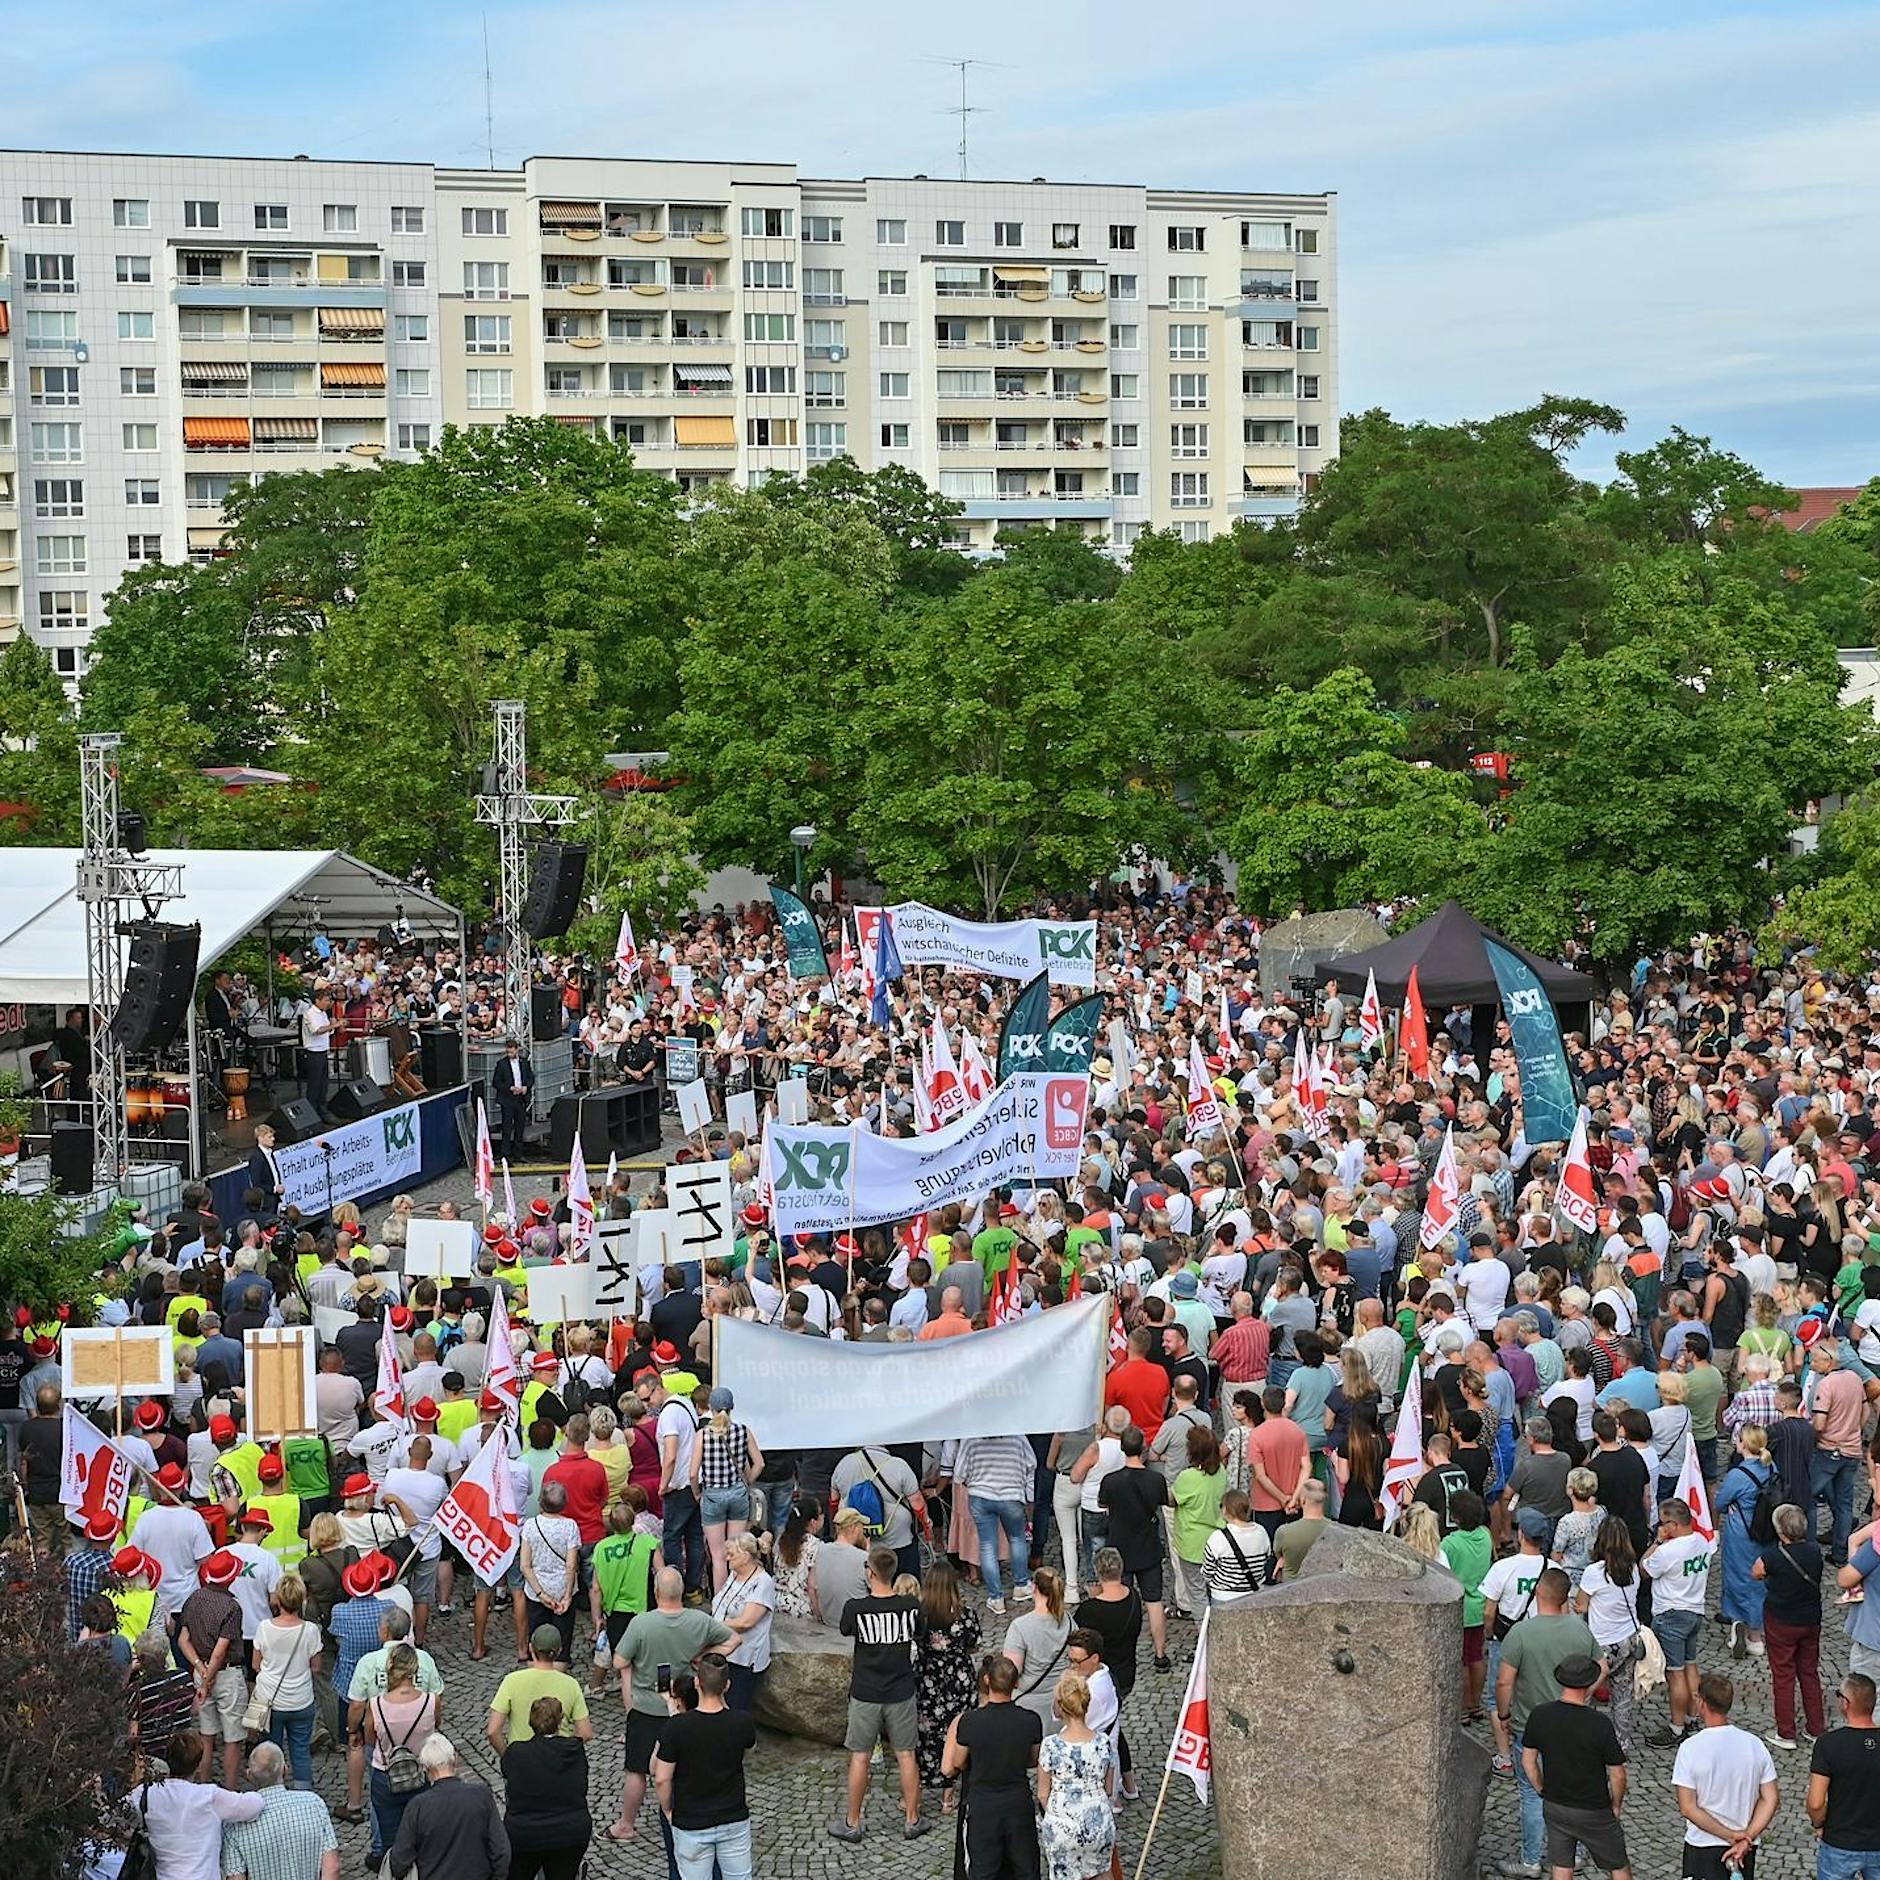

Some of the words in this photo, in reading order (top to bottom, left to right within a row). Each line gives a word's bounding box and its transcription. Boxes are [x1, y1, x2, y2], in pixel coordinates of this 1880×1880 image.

[1479, 757, 1494, 766] 112
[1038, 928, 1094, 960] PCK
[987, 949, 1029, 968] Defizite
[1009, 1034, 1044, 1057] PCK
[1050, 1032, 1089, 1056] PCK
[383, 1109, 416, 1153] PCK
[282, 1153, 307, 1179] Erhalt
[342, 1134, 373, 1157] Arbeits-
[993, 1240, 1013, 1255] PCK
[437, 1499, 502, 1575] IGBCE
[1683, 1551, 1709, 1577] PCK
[1517, 1576, 1537, 1596] PC
[856, 1608, 919, 1644] ADIDAS
